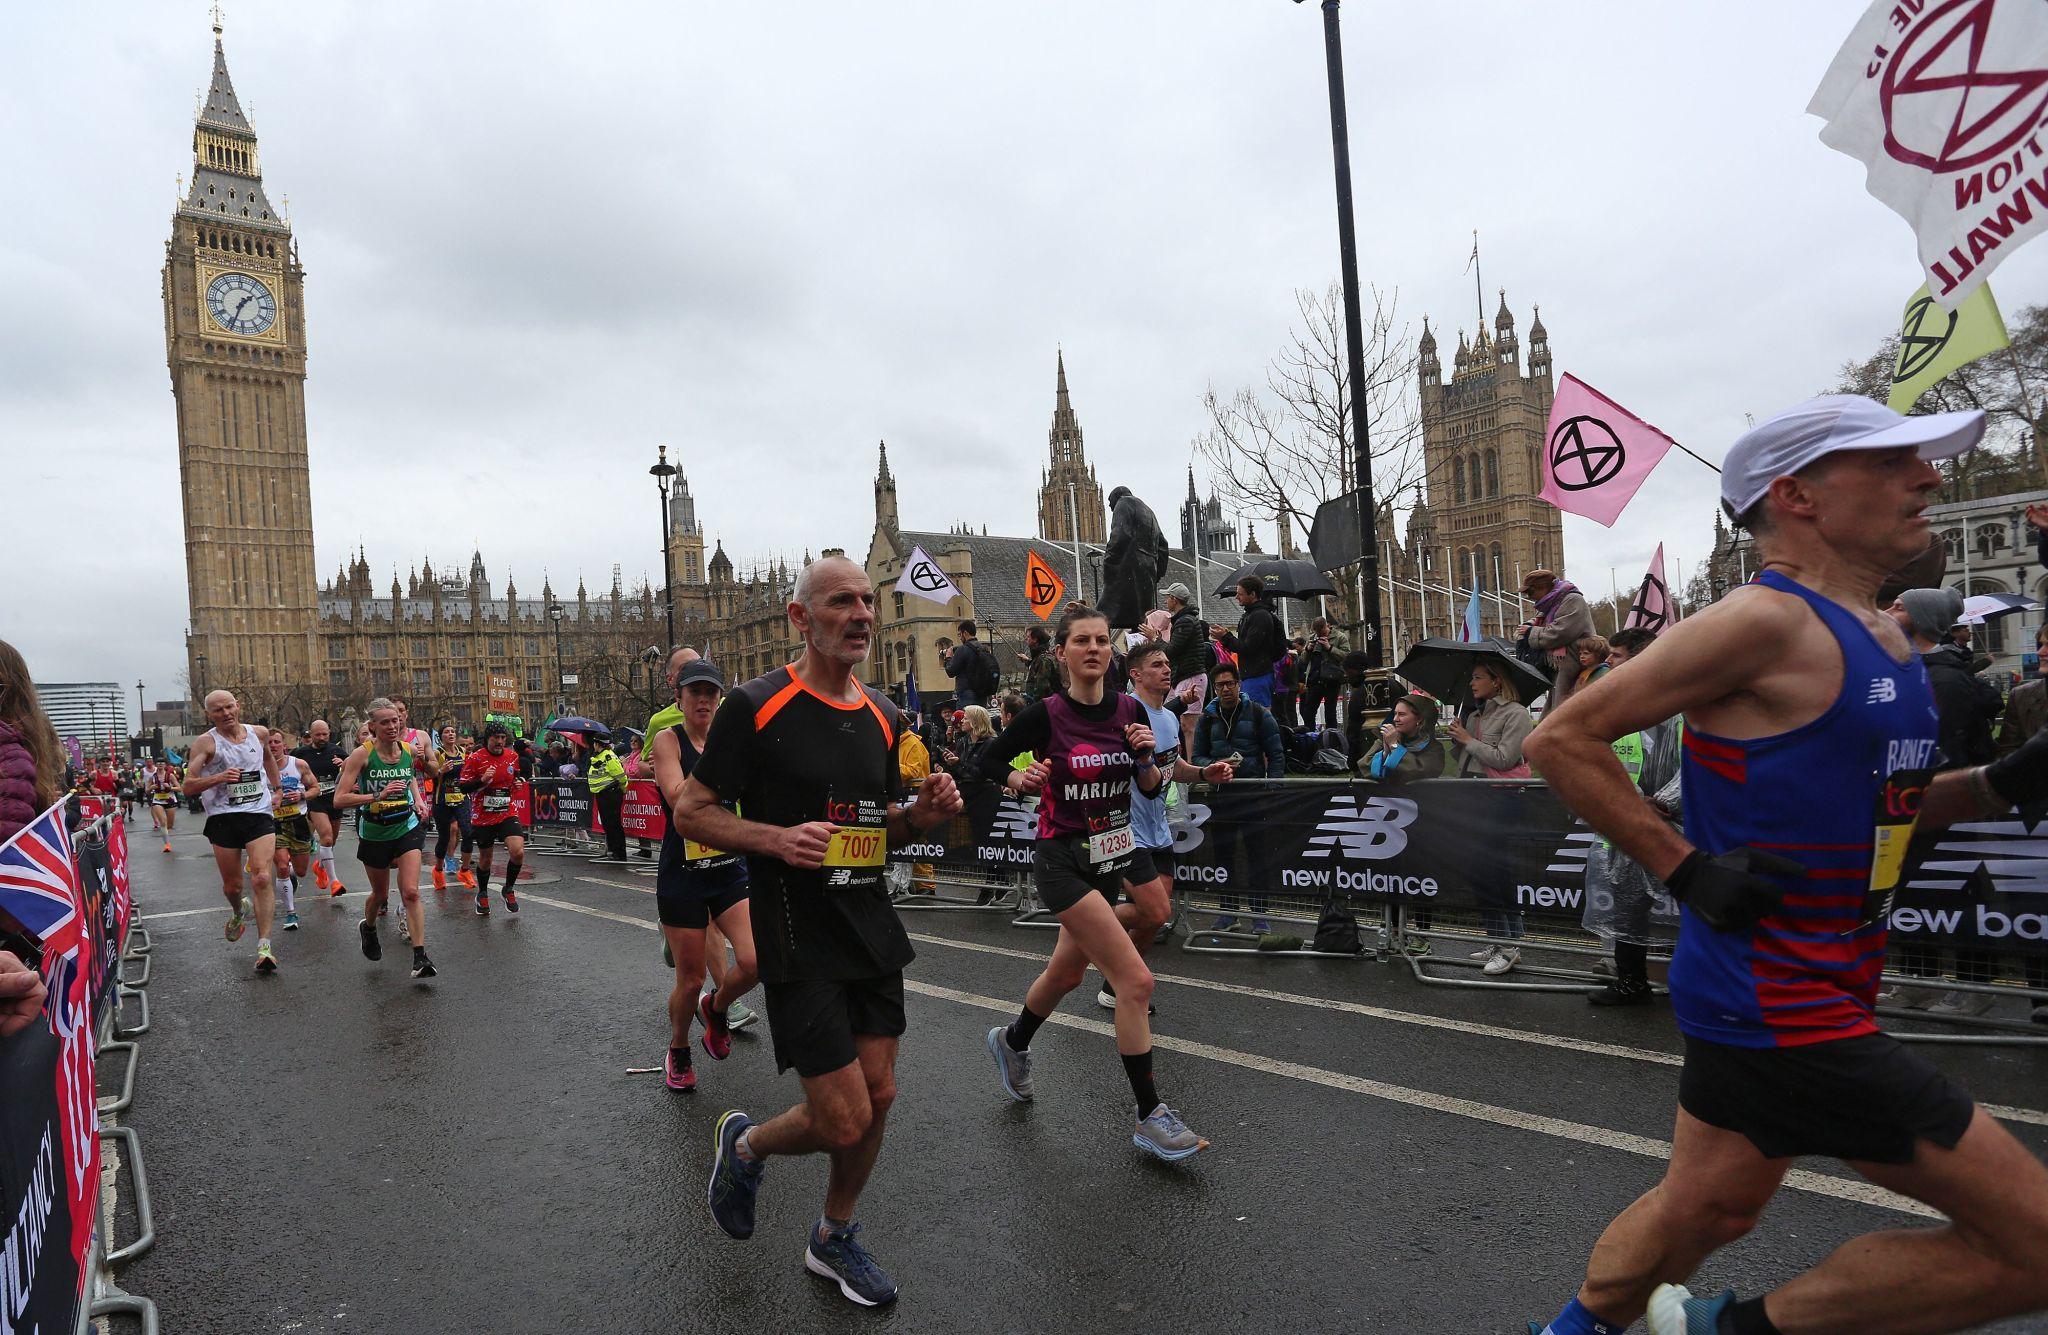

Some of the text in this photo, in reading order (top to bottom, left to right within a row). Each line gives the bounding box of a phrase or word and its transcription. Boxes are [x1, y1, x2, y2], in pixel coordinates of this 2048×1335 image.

[493, 677, 515, 688] PLASTIC
[510, 691, 517, 700] OF
[369, 767, 412, 778] CAROLINE
[558, 787, 573, 797] TATA
[534, 787, 558, 820] tcs
[558, 799, 588, 811] CONSULTANCY
[622, 803, 662, 816] CONSULTANCY
[558, 811, 577, 822] SERVICES
[858, 815, 882, 823] SERVICES
[622, 817, 647, 830] SERVICES
[841, 836, 880, 859] 7007
[977, 846, 1006, 860] new
[1282, 865, 1439, 897] new balance
[1516, 884, 1583, 909] new
